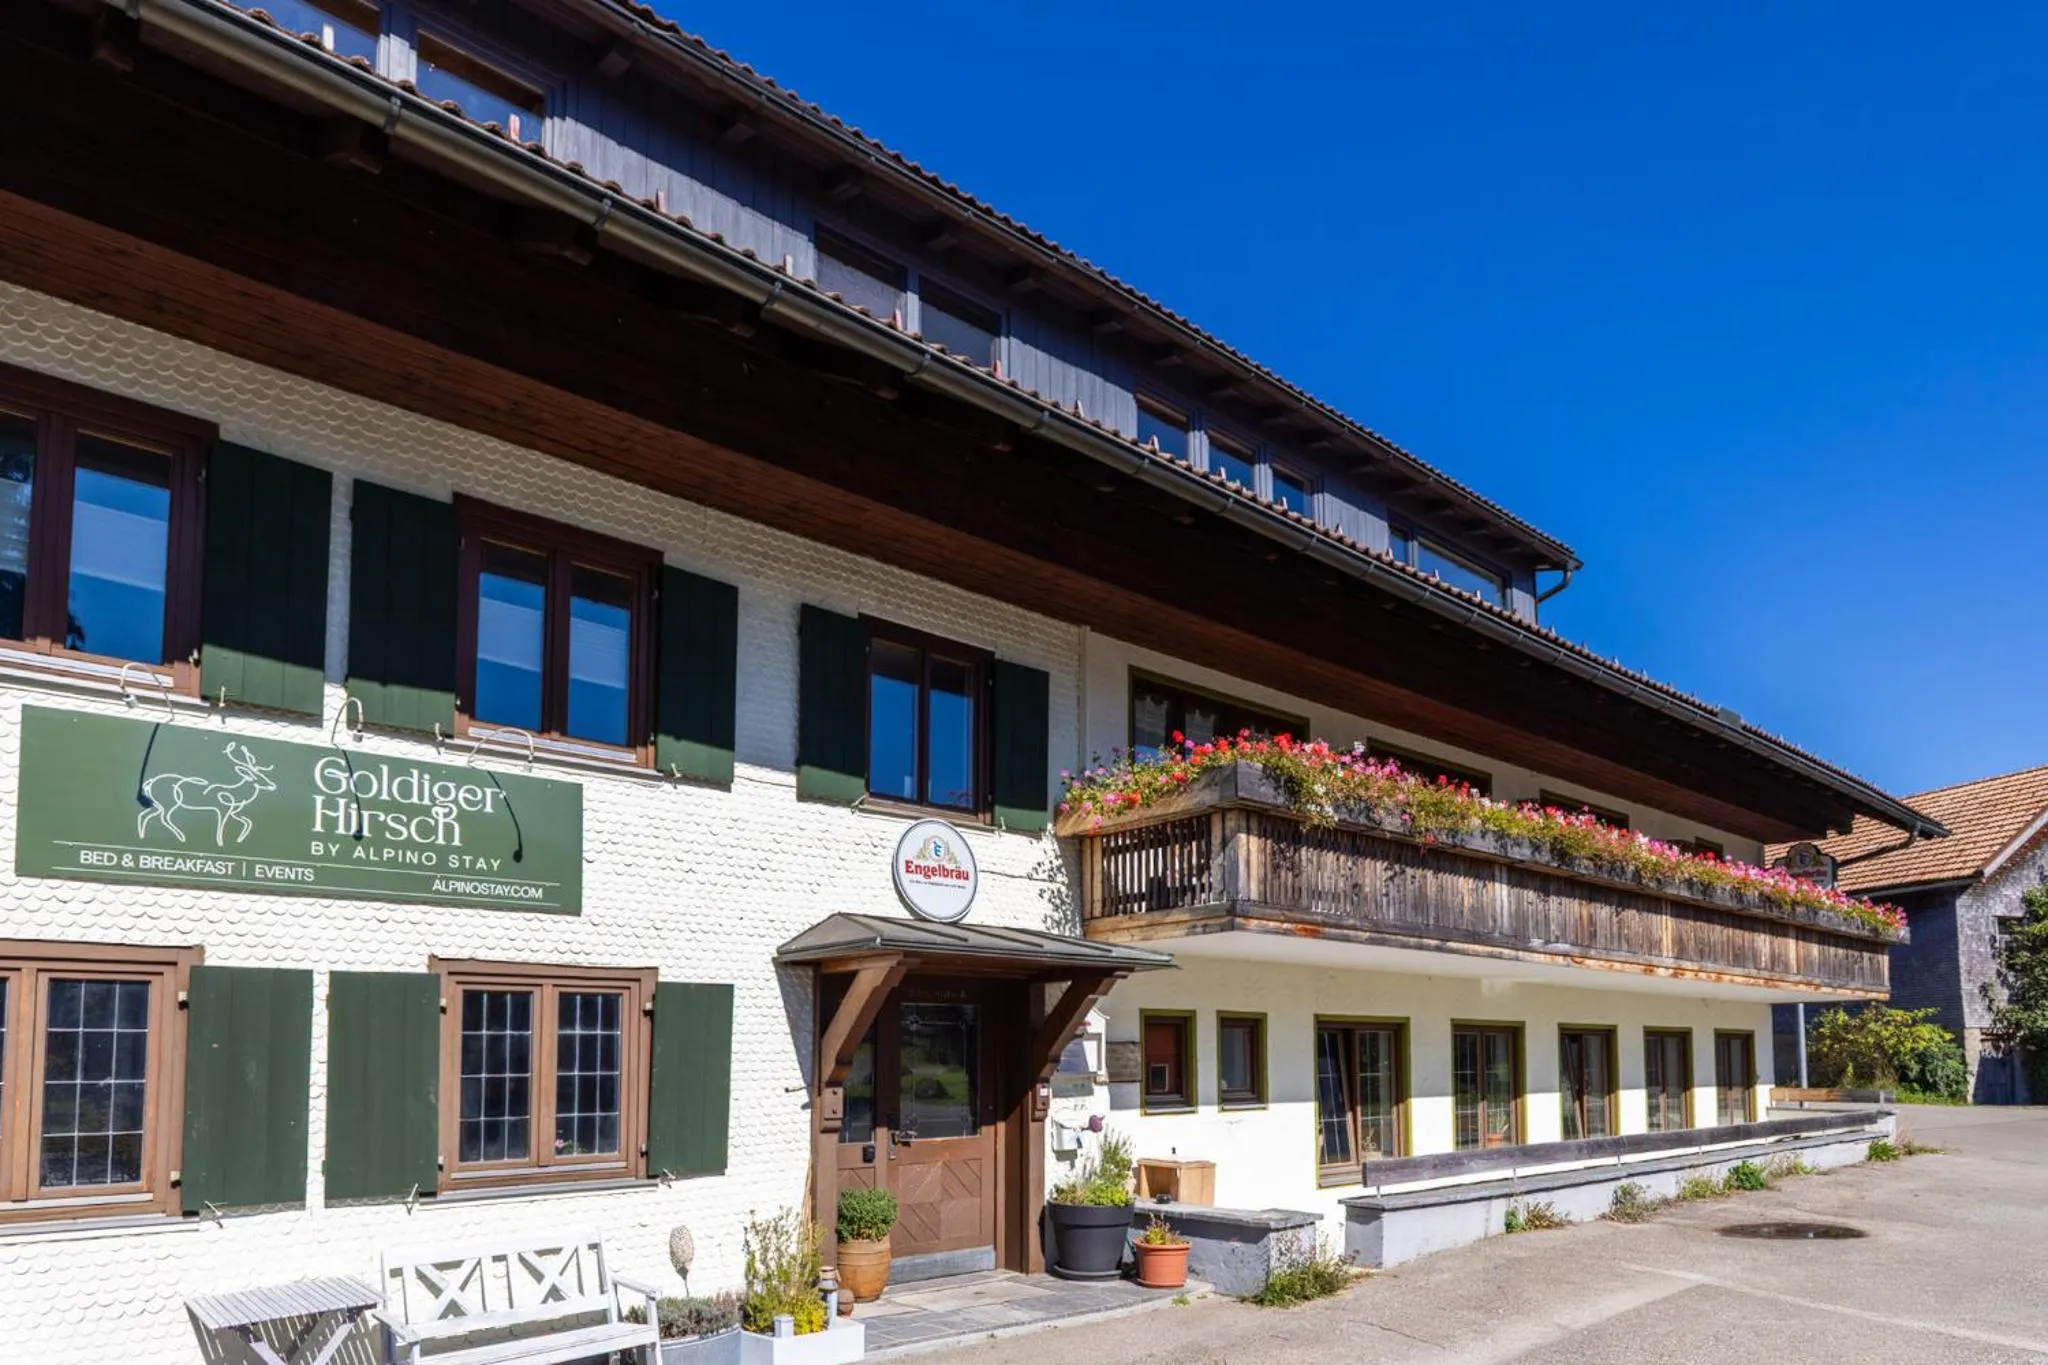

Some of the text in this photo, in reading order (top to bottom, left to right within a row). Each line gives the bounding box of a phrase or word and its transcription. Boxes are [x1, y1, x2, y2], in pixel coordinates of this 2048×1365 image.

[314, 756, 506, 820] Goldiger
[312, 795, 463, 846] Hirsch
[80, 850, 235, 875] BED & BREAKFAST
[311, 841, 501, 871] BY ALPINO STAY
[254, 864, 314, 881] EVENTS
[904, 860, 969, 880] Engelbräu
[432, 879, 543, 899] ALPINOSTAY.COM
